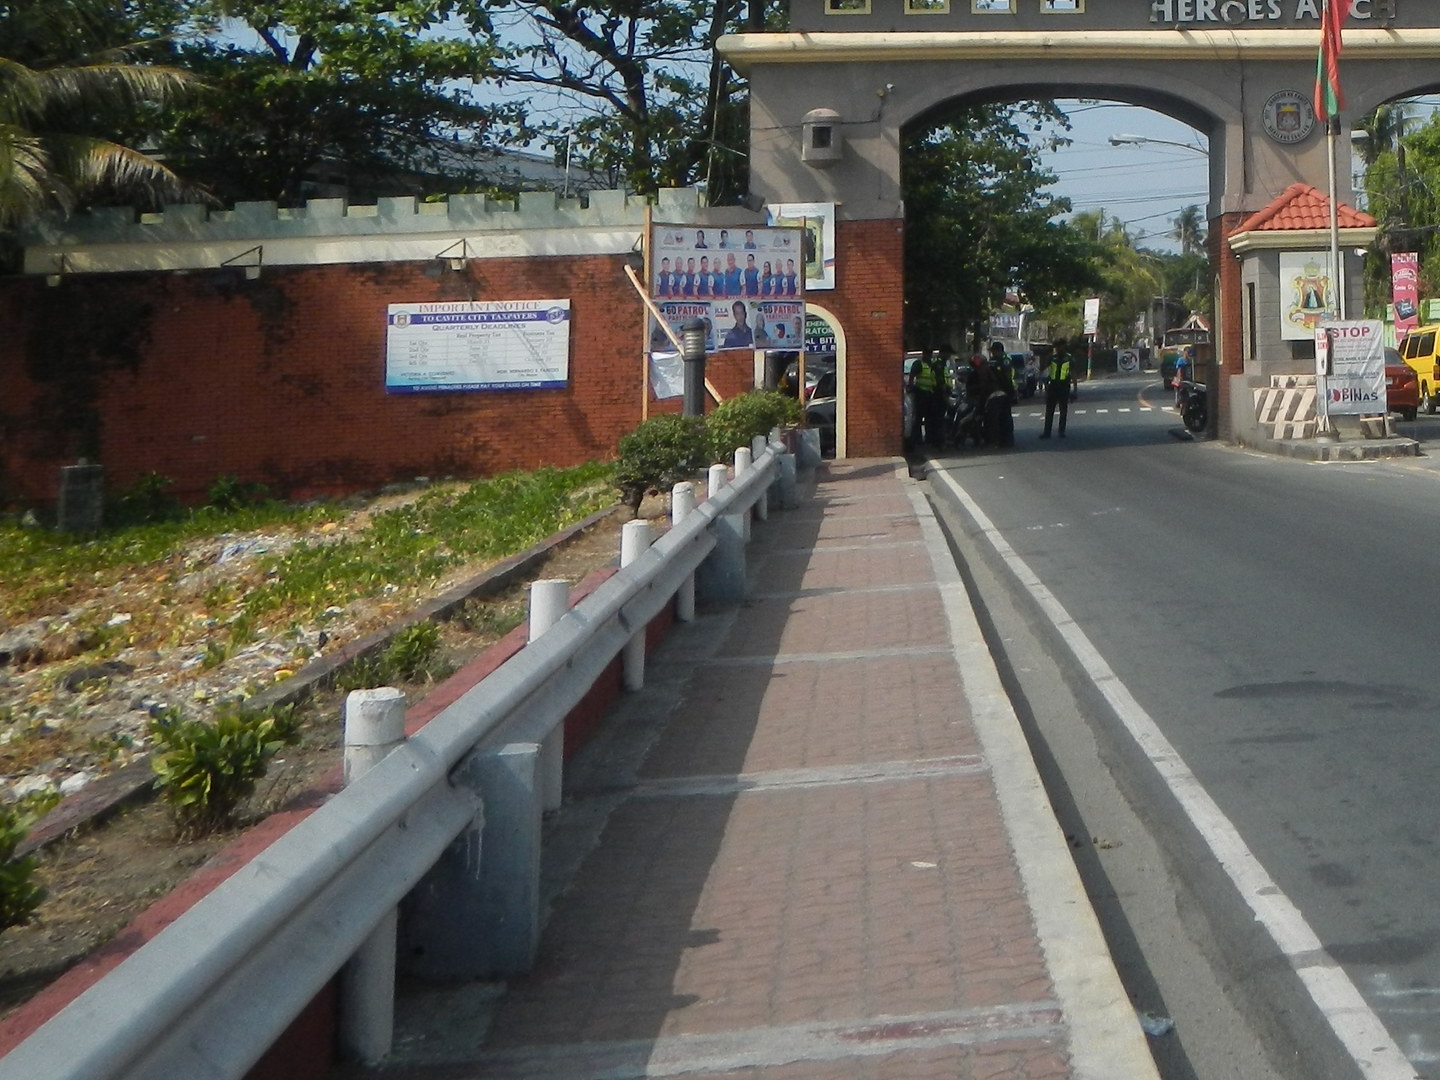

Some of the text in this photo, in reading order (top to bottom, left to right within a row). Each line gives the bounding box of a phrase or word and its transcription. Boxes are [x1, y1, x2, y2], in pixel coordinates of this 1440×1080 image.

[419, 302, 541, 313] IMPORTANT NOTICE
[677, 305, 709, 315] PATROL
[774, 305, 801, 314] PATROL
[435, 314, 466, 322] CAVITE
[467, 313, 488, 321] CITY
[491, 312, 537, 321] TAXPAYERS
[1333, 327, 1370, 338] STOP
